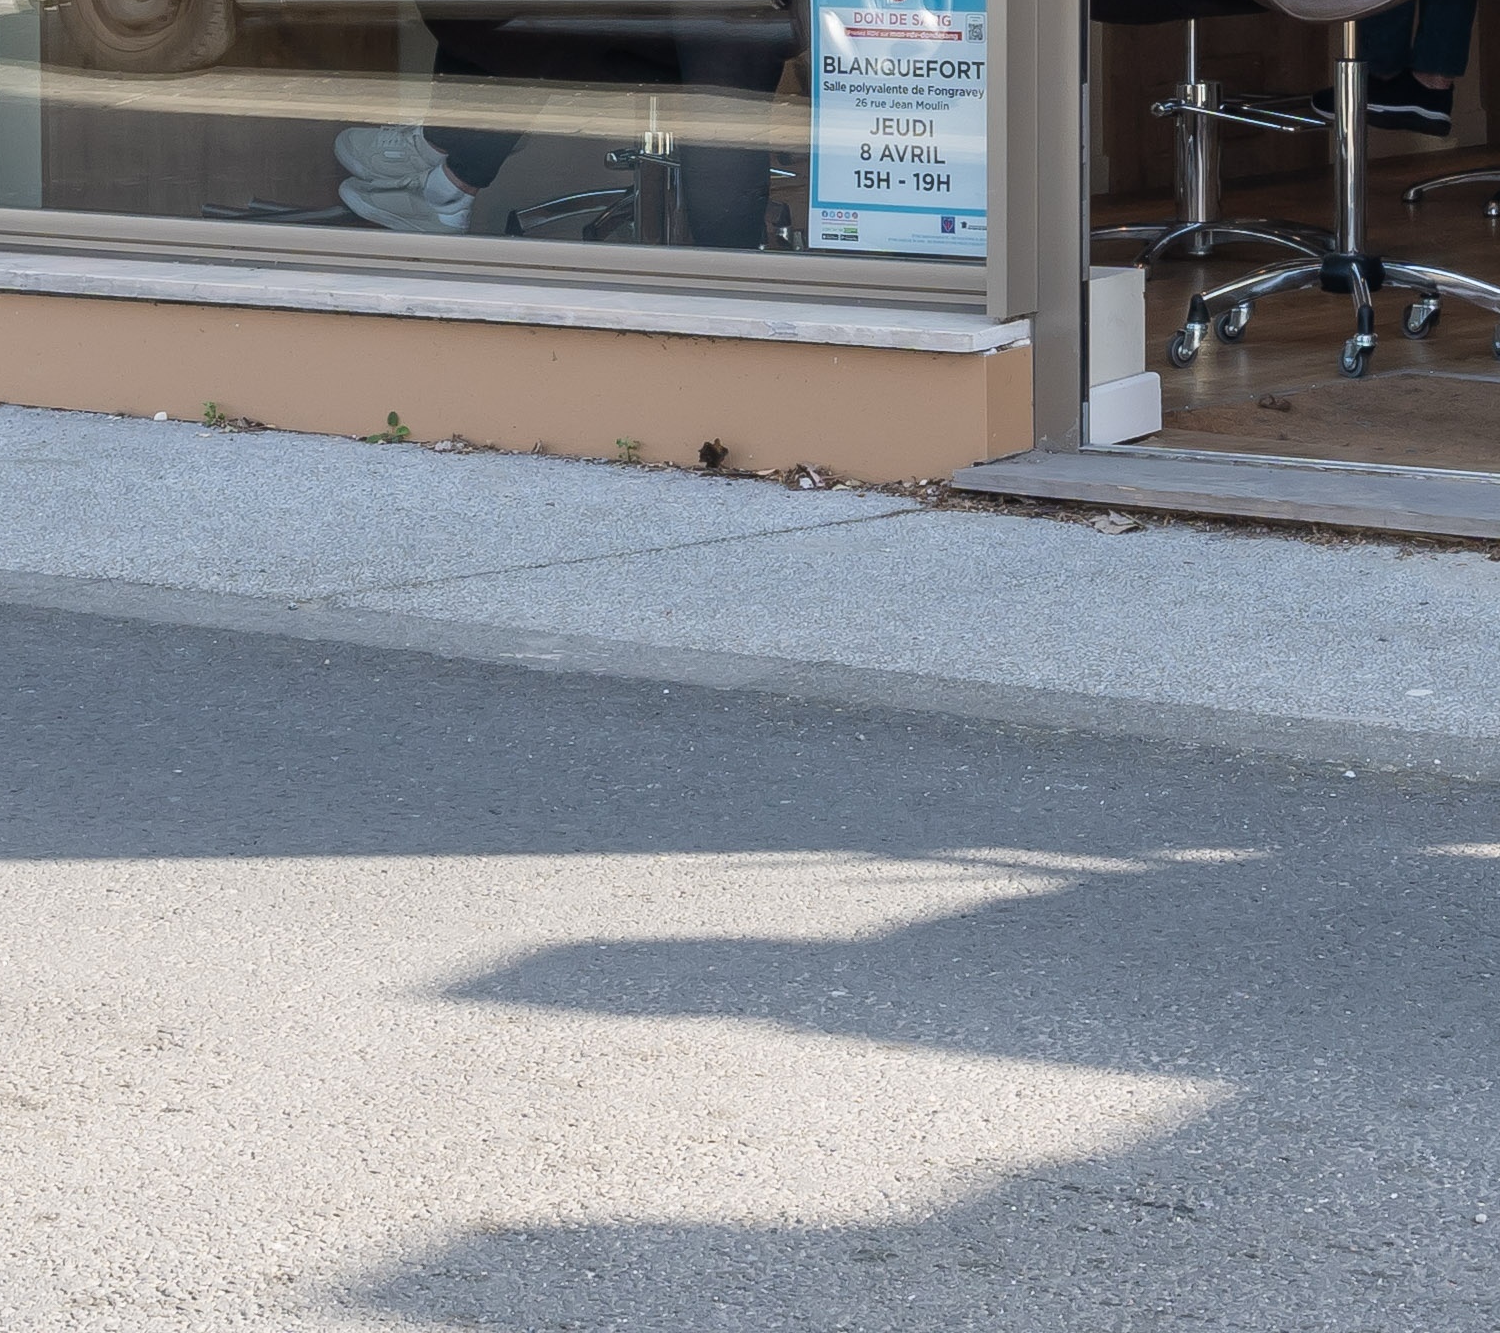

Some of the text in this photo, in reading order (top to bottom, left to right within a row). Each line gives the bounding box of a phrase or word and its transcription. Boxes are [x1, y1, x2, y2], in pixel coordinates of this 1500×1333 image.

[853, 11, 952, 27] DON DE SG
[823, 55, 985, 80] BLANQUEFORT
[823, 80, 985, 100] Salle polyvalente de Fongravey
[855, 98, 950, 111] 26 rue Jean Moulin
[869, 117, 934, 138] JEUDI
[860, 143, 946, 164] 8 AVRIL
[854, 170, 891, 190] 15H
[912, 172, 951, 192] 19H
